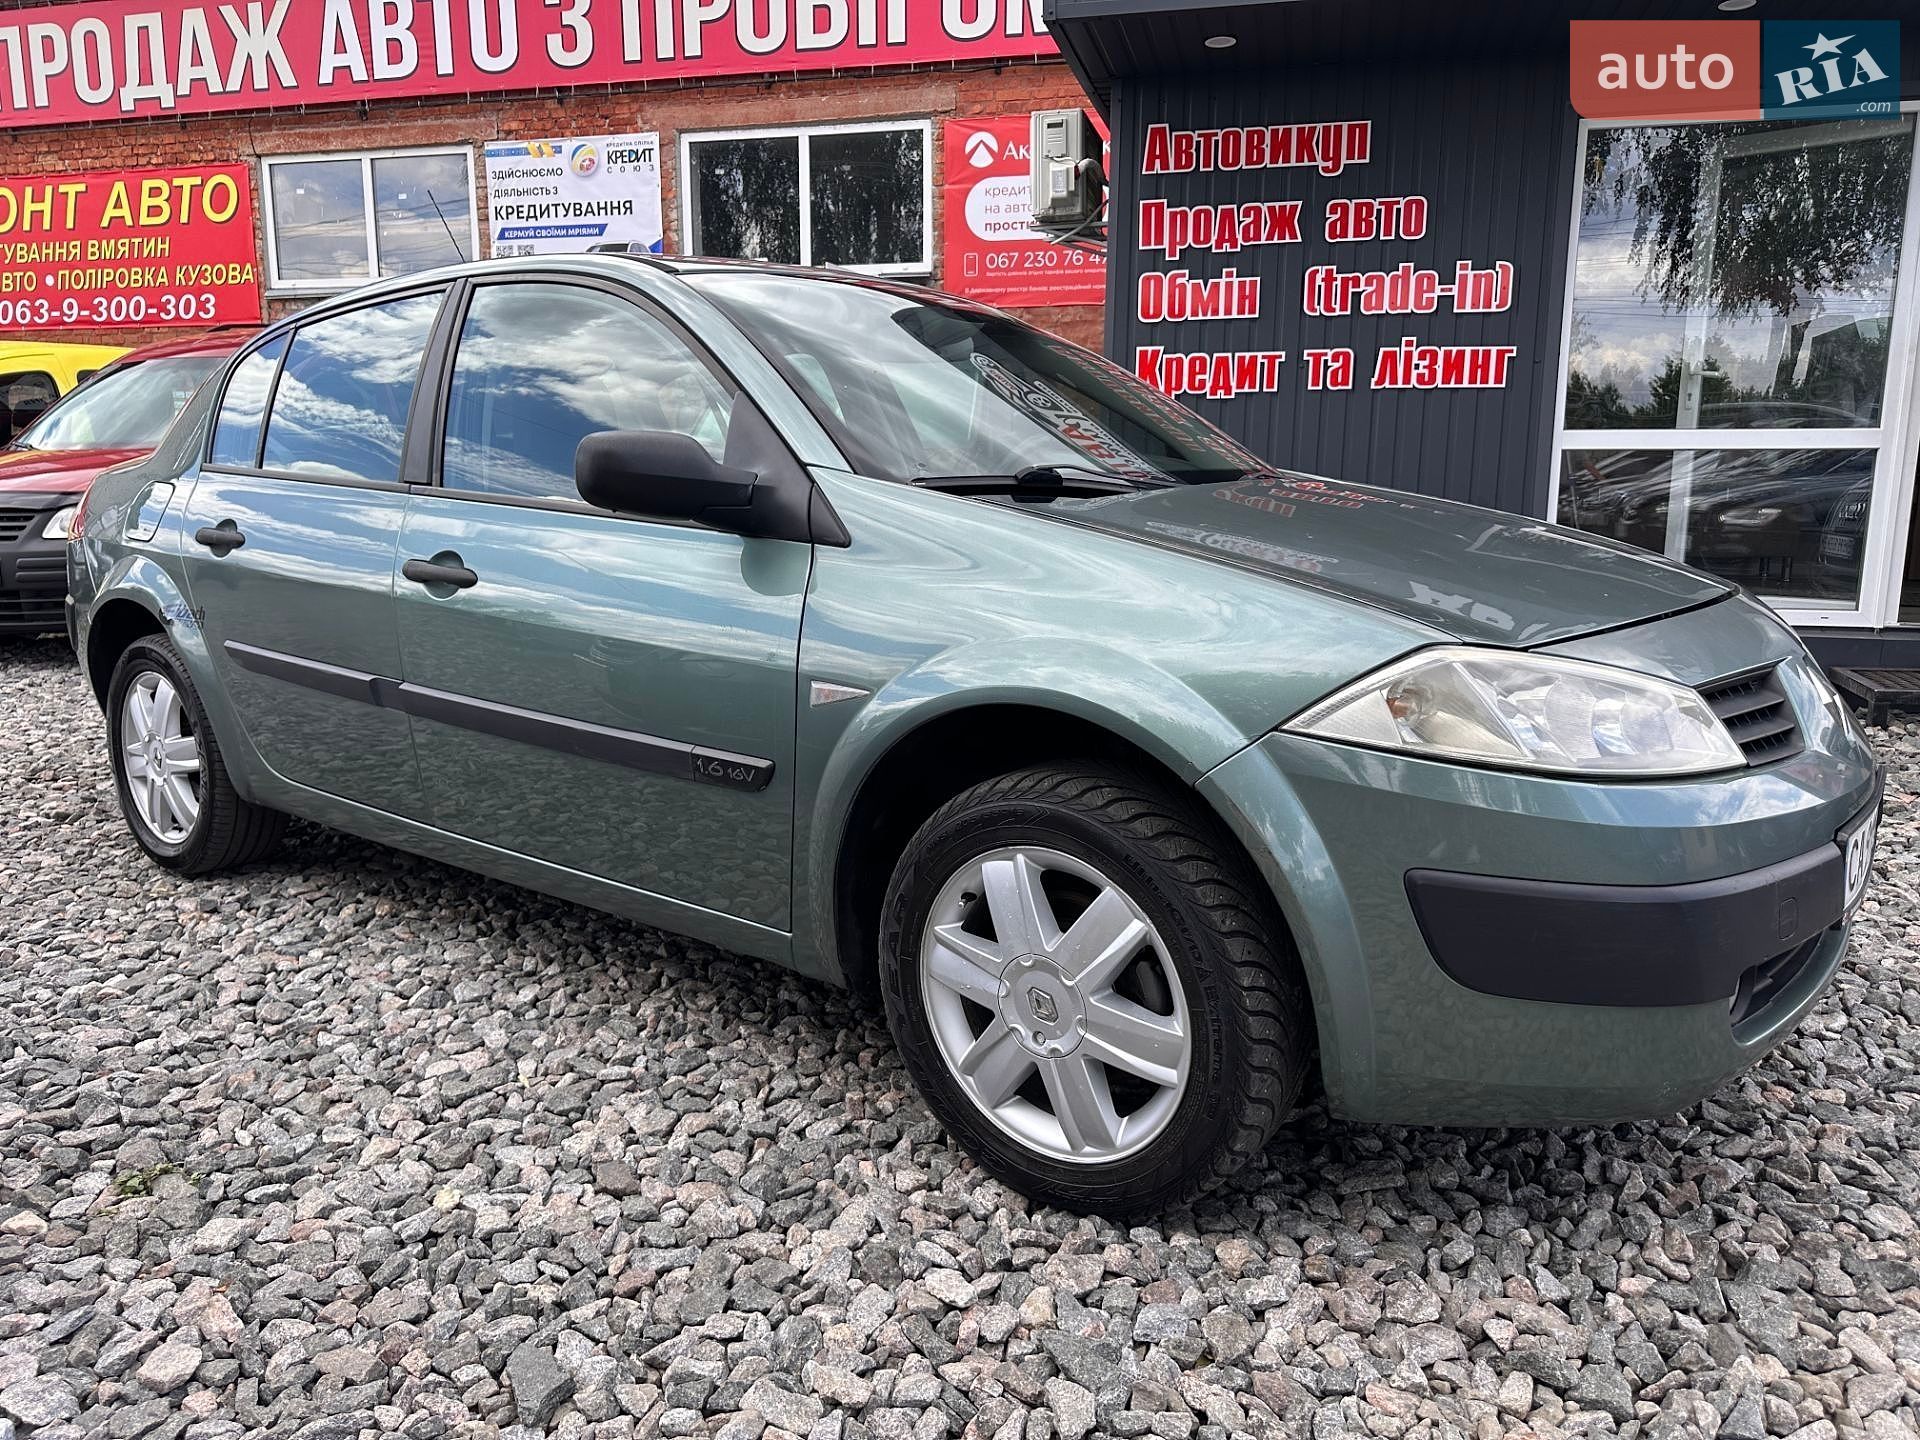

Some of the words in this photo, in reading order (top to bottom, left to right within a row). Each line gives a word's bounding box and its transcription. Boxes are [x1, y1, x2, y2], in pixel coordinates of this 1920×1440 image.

[0, 0, 298, 112] ПРОДАЖ
[318, 0, 519, 85] АВТО
[1142, 120, 1371, 176] Автовикуп
[491, 167, 563, 180] ЗДІЙСНЮЄМО
[100, 174, 239, 229] АВТО
[493, 187, 550, 199] ДІЯЛЬНІСТЬ
[494, 200, 633, 221] КРЕДИТУВАННЯ
[985, 205, 1000, 214] на
[504, 228, 534, 238] КЕРМУЙ
[535, 226, 567, 237] СВОЇМИ
[568, 226, 599, 236] МРІЯМИ
[1139, 199, 1302, 260] Продаж
[1325, 196, 1427, 242] авто
[87, 236, 171, 261] ВМЯТИН
[986, 252, 1019, 269] 067
[1024, 250, 1057, 267] 230
[1063, 249, 1084, 266] 76
[0, 271, 38, 293] ВТО
[57, 266, 169, 290] ПОЛІРОВКА
[175, 262, 254, 287] КУЗОВА
[1138, 268, 1260, 322] Обмін
[1304, 260, 1514, 315] (trade-in)
[0, 293, 217, 325] 063-9-300-303
[1136, 346, 1285, 399] Кредит
[1304, 347, 1353, 390] та
[1371, 337, 1516, 389] лізинг
[697, 758, 724, 777] 1.6
